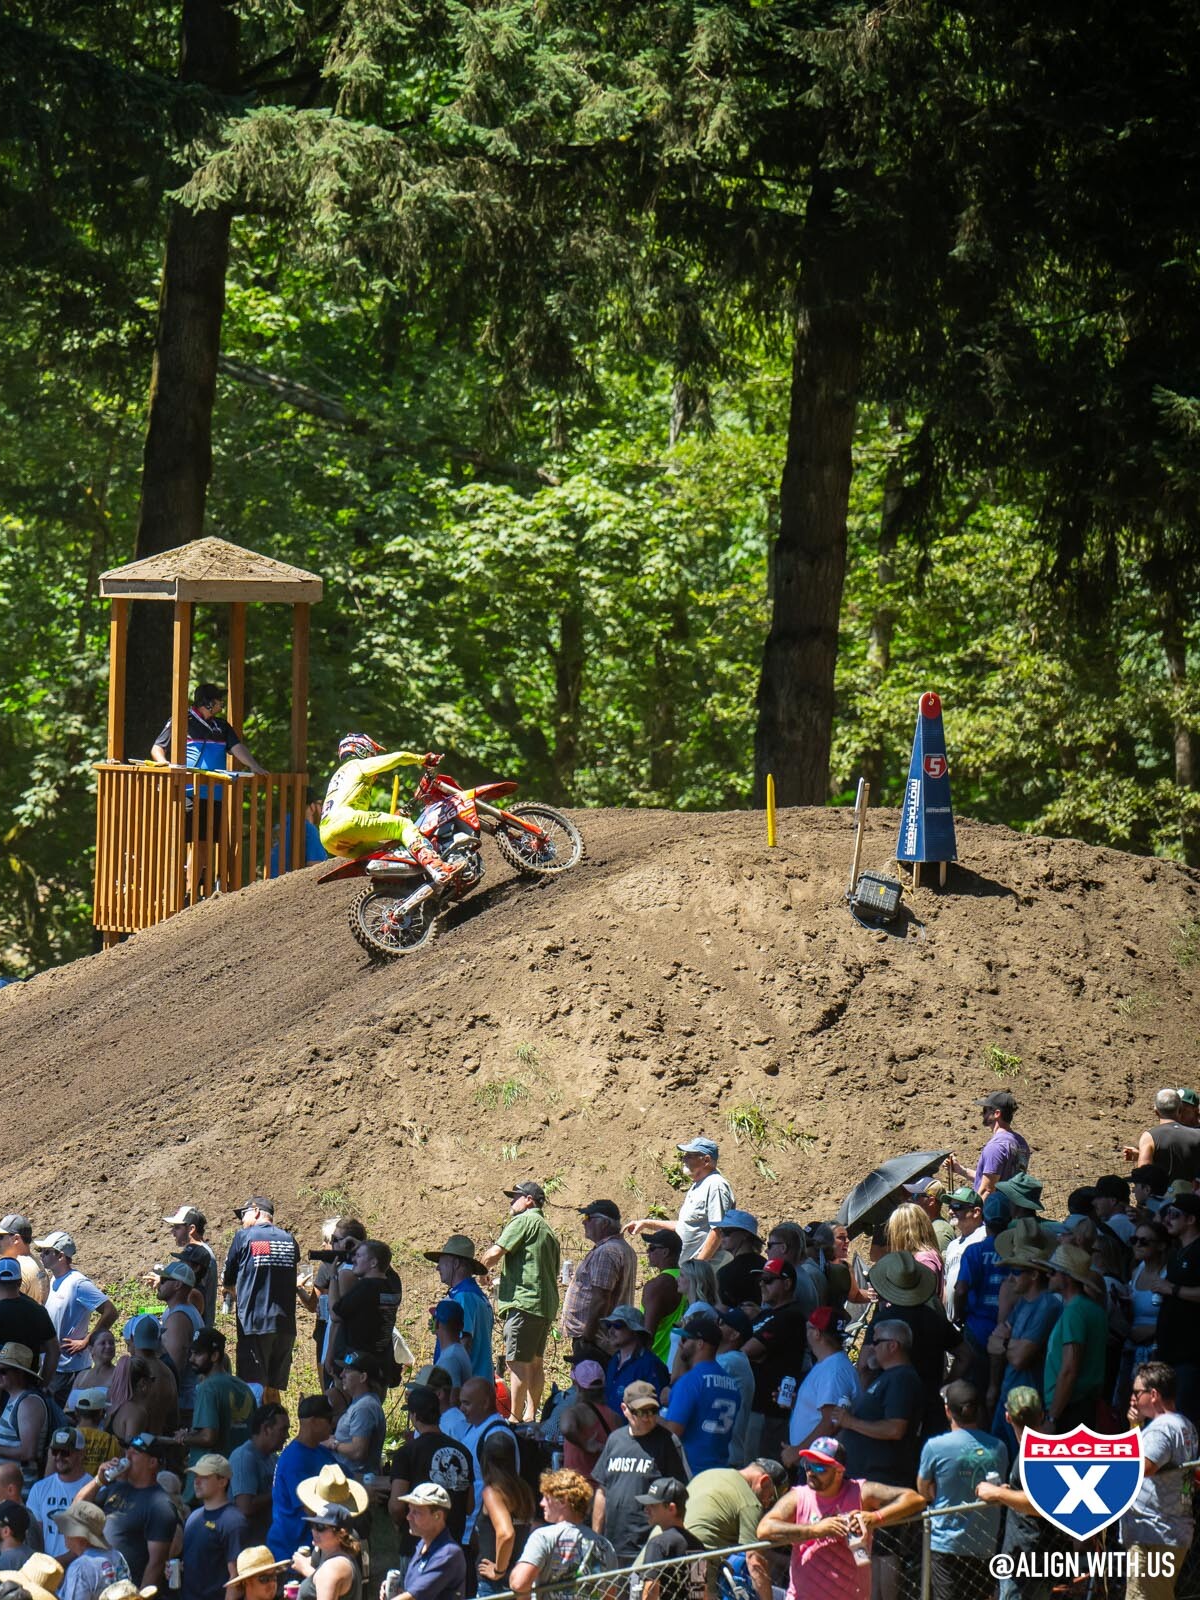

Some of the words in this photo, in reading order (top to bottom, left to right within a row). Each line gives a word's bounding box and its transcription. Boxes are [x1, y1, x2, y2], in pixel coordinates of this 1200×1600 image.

[929, 757, 941, 775] 5
[906, 778, 918, 856] MOTOCROSS
[701, 1398, 737, 1435] 3
[607, 1456, 637, 1473] MOIST
[635, 1458, 652, 1474] AF
[47, 1496, 75, 1506] OA
